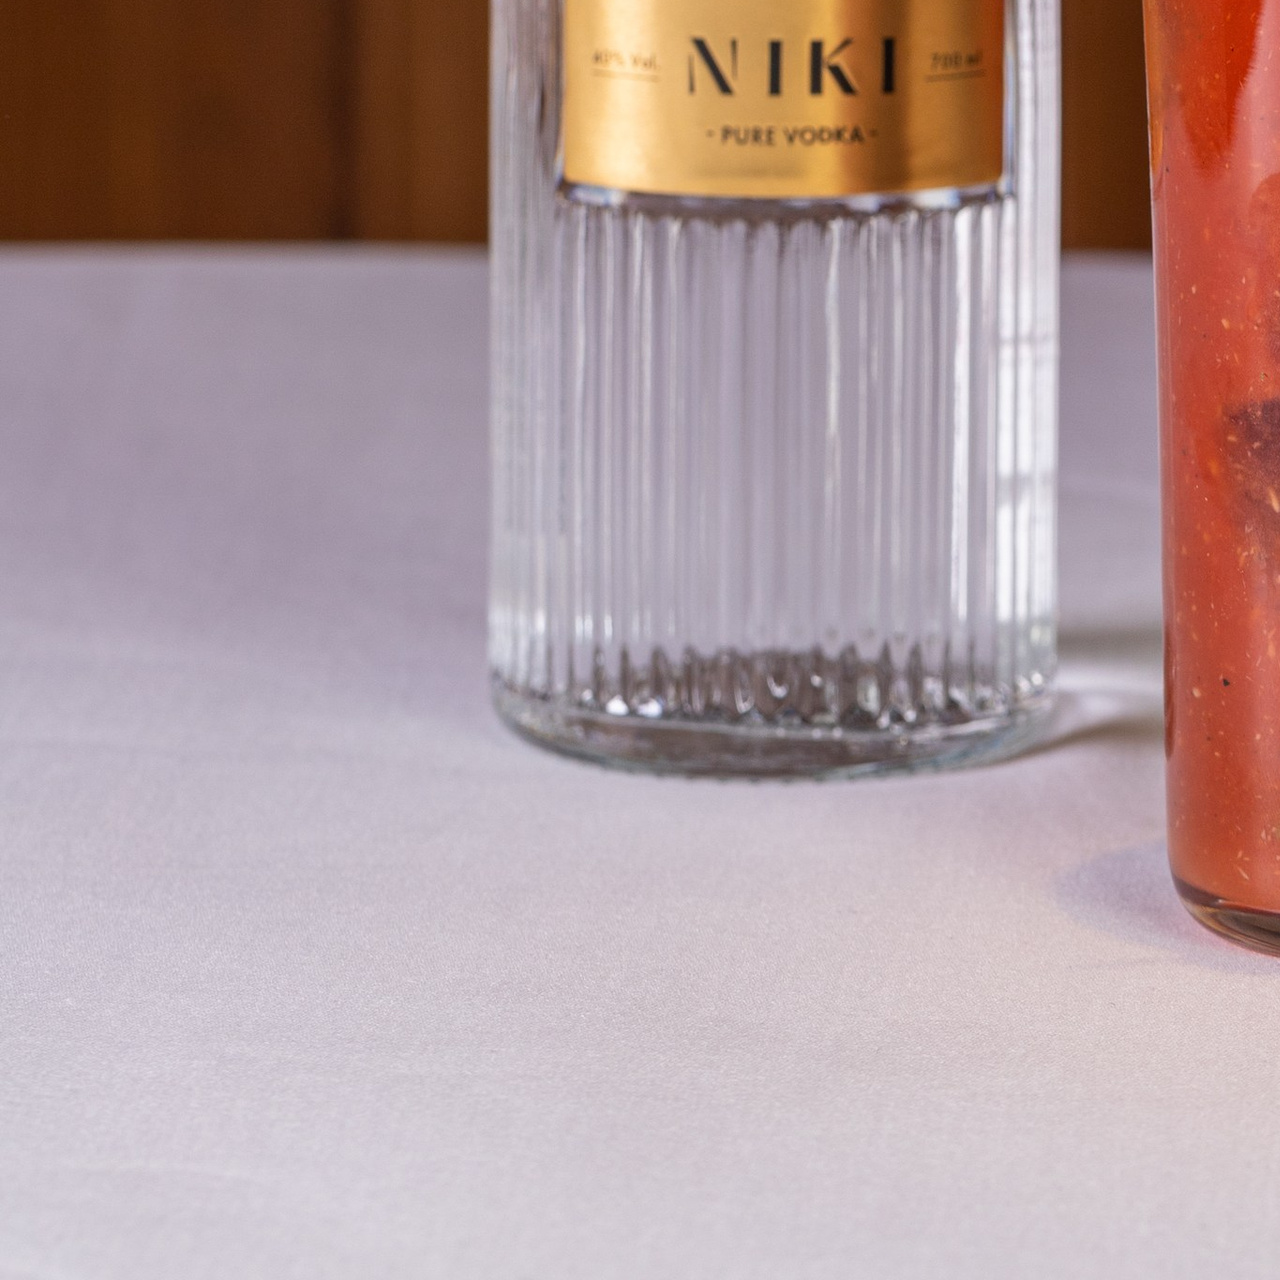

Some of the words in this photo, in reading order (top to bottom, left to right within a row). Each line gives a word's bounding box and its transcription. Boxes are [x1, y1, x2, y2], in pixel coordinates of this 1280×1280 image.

[687, 36, 897, 97] NIKI
[720, 125, 776, 147] PURE
[784, 125, 865, 147] VODKA
